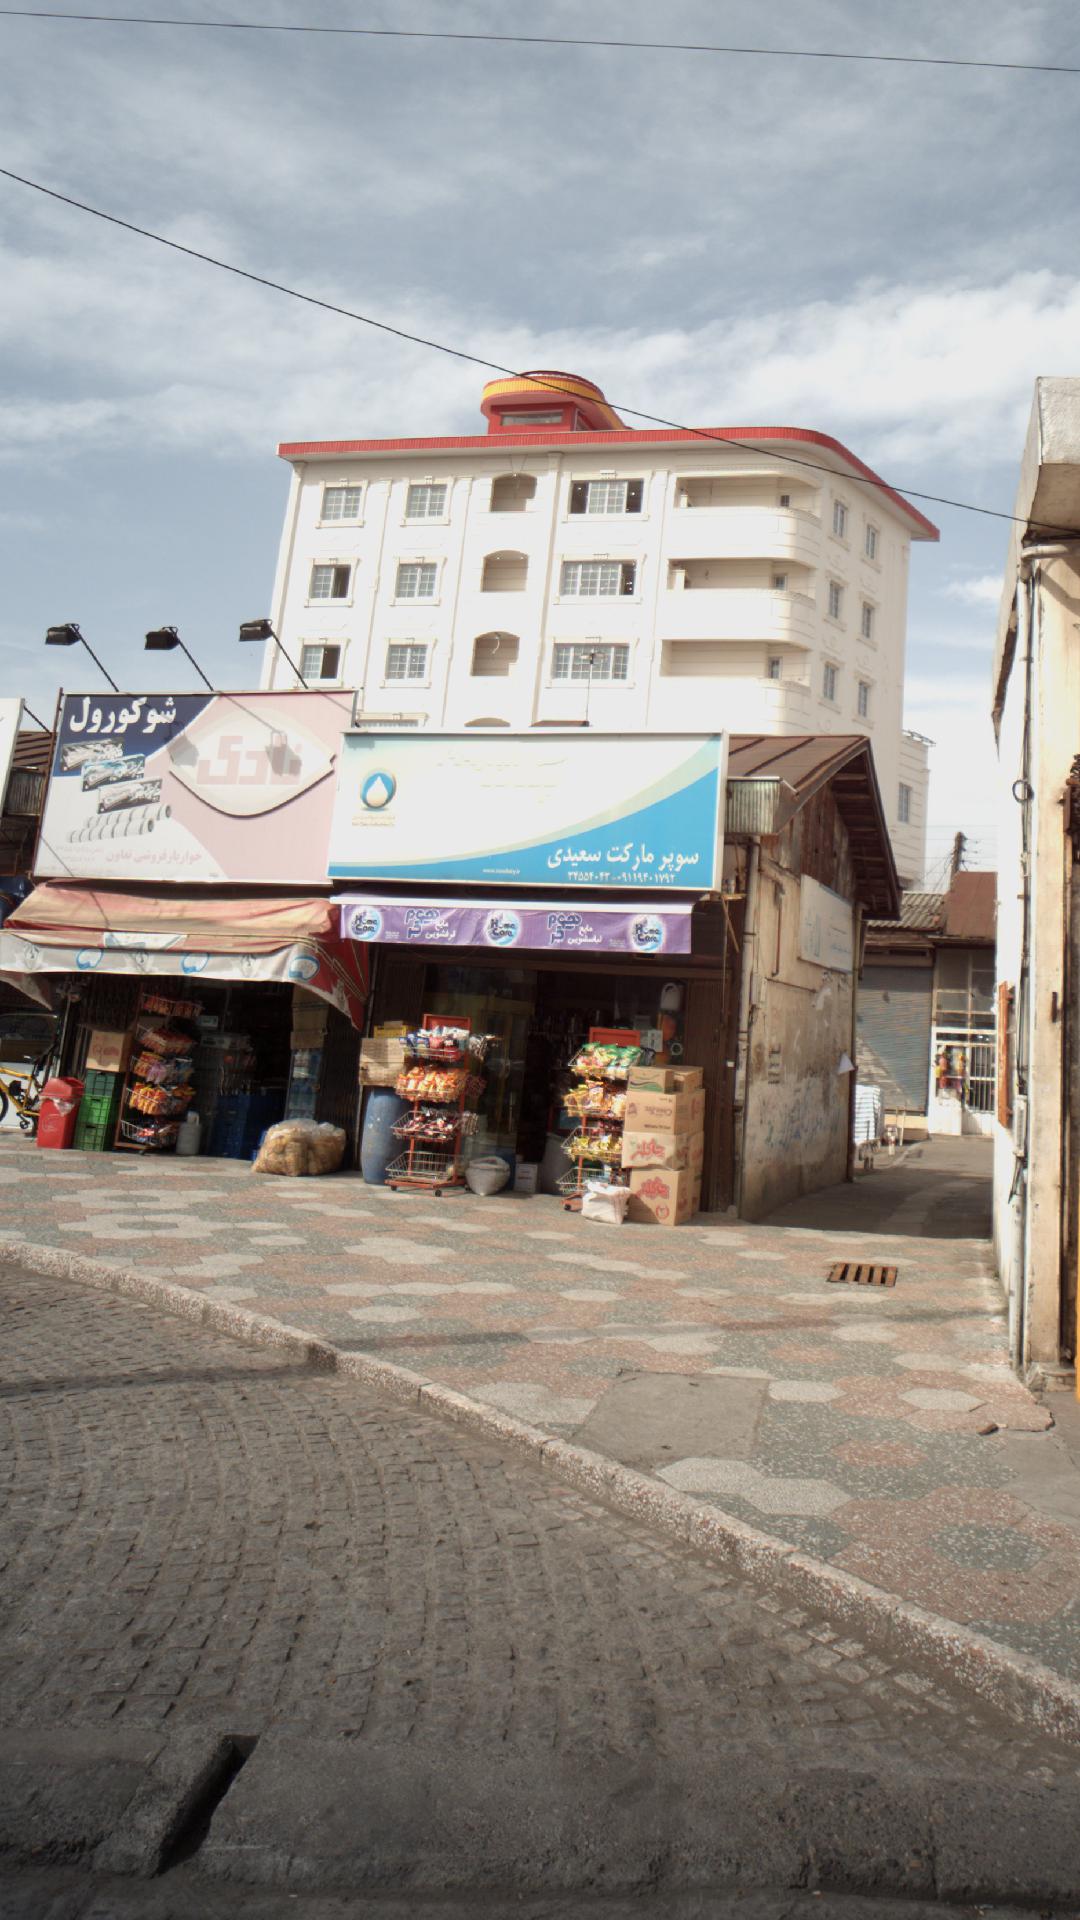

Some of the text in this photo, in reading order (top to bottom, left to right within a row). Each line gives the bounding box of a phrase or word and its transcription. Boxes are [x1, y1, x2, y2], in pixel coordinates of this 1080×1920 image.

[547, 842, 699, 872] سوپر مارکت سعیدی
